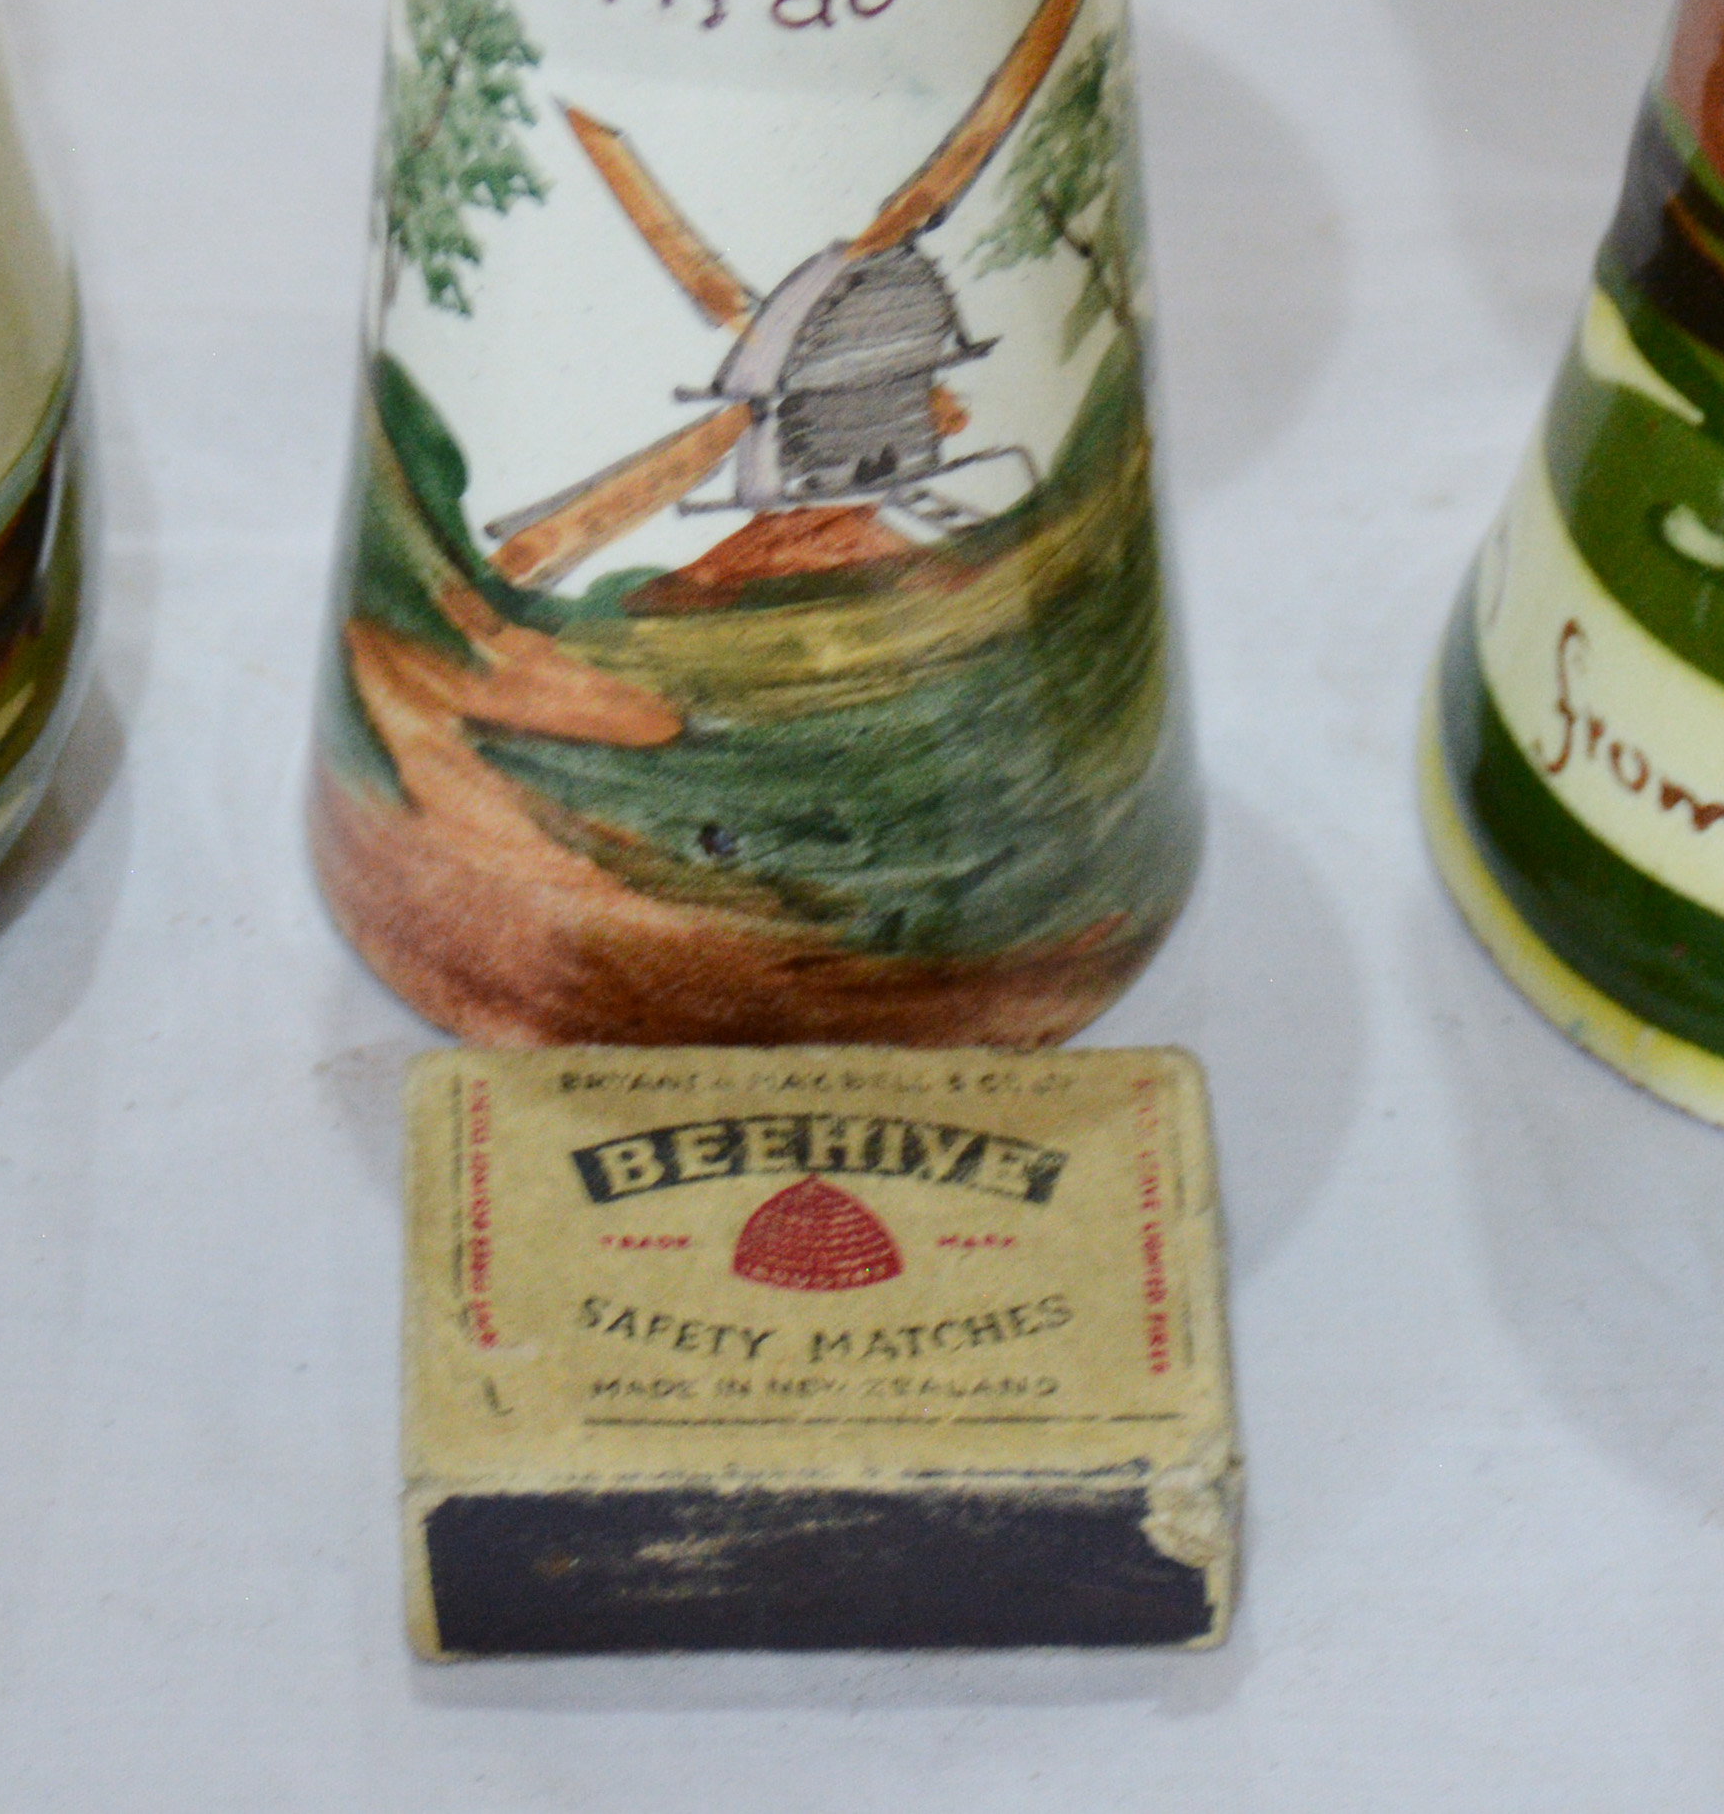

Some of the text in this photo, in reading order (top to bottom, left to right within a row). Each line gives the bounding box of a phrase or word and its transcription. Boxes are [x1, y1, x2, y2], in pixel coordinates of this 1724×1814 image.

[592, 1118, 1033, 1198] BEEHIVE
[579, 1291, 1076, 1365] SAFETY MATCHES
[590, 1376, 697, 1400] MADE
[862, 1374, 1062, 1399] ZEALAND
